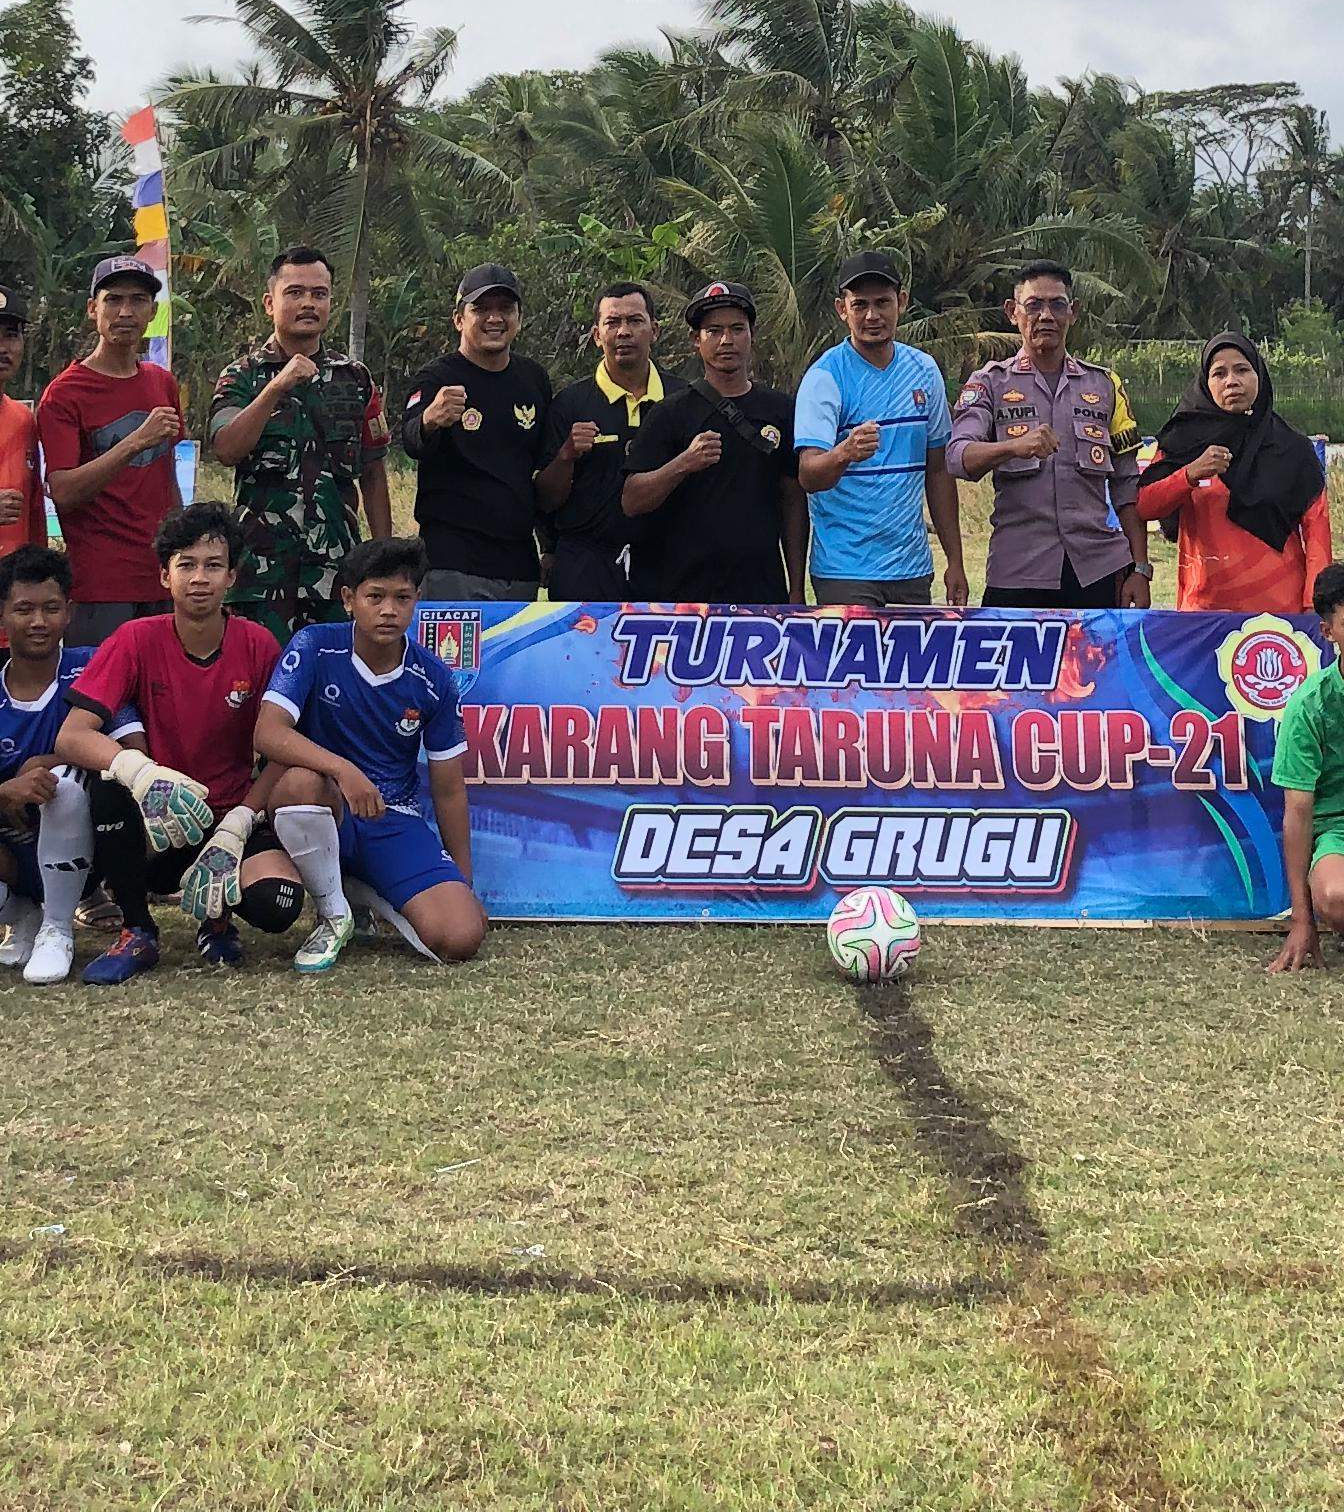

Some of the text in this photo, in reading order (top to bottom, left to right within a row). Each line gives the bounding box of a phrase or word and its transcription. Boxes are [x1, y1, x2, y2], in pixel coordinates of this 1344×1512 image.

[422, 611, 479, 620] CILACAP
[613, 614, 1066, 690] TURNAMEN
[461, 704, 1248, 791] KARANG TARUNA CUP-21
[616, 810, 1067, 882] DESA GRUGU
